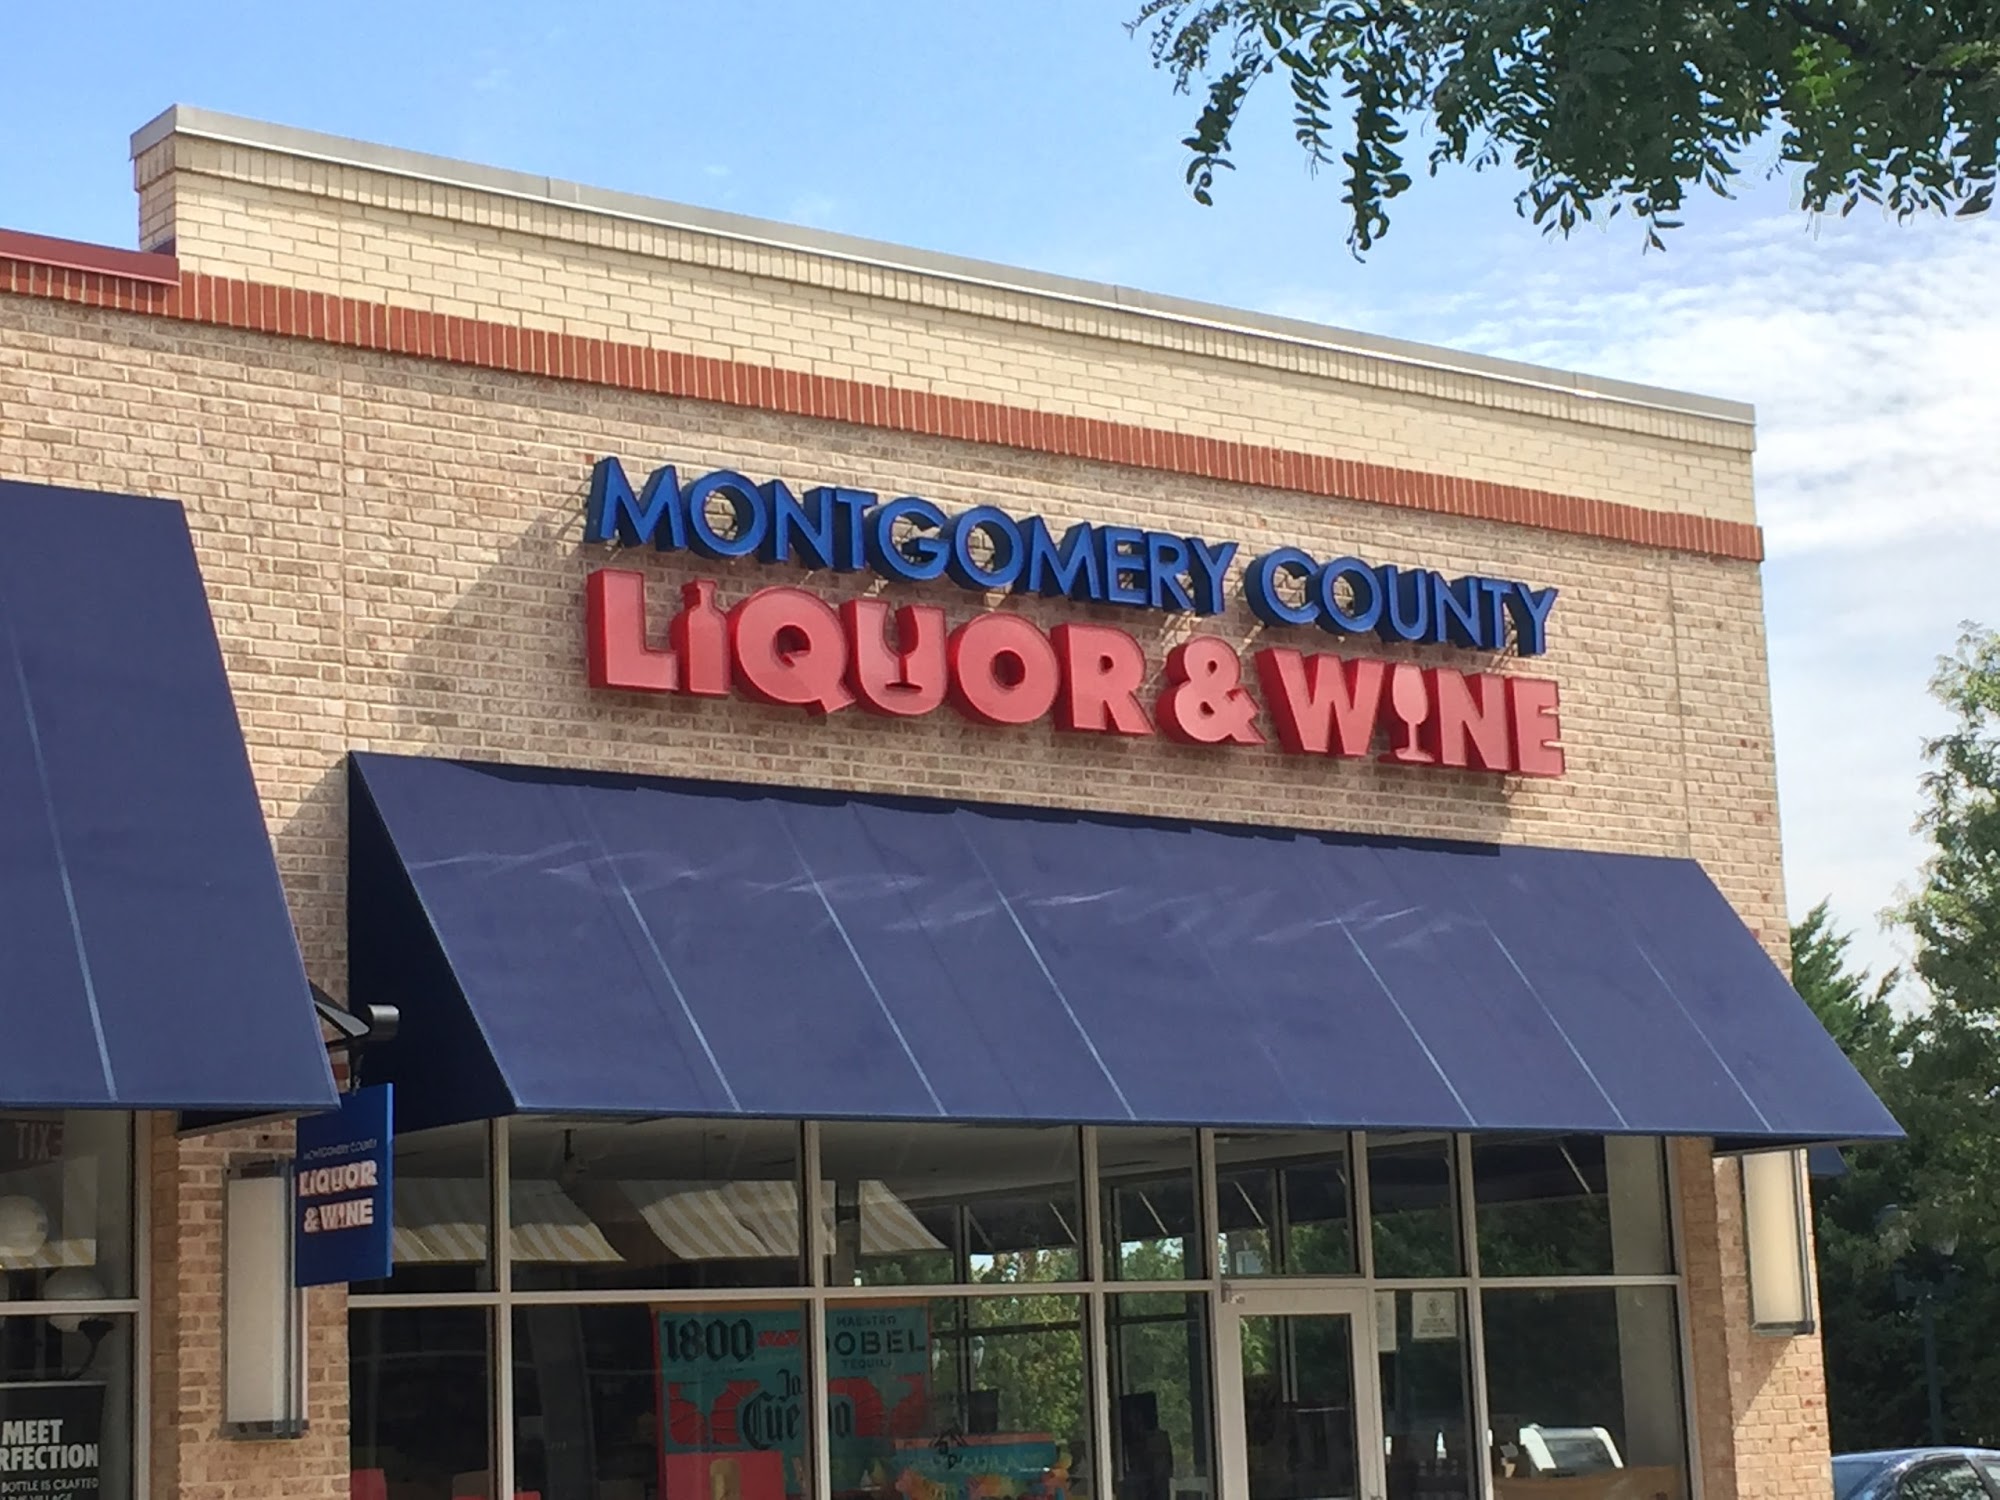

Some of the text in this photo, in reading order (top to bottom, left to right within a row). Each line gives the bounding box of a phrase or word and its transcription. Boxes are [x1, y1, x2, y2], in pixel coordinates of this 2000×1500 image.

[584, 456, 1558, 657] MONTGOMERY COUNTY
[586, 568, 1567, 777] LIQUOR & WINE
[299, 1160, 378, 1197] LIQUOR
[319, 1198, 374, 1230] WINE
[664, 1317, 754, 1363] 1800
[825, 1329, 927, 1356] OBEL
[2, 1419, 64, 1445] MEET
[2, 1481, 38, 1493] BOTTLE
